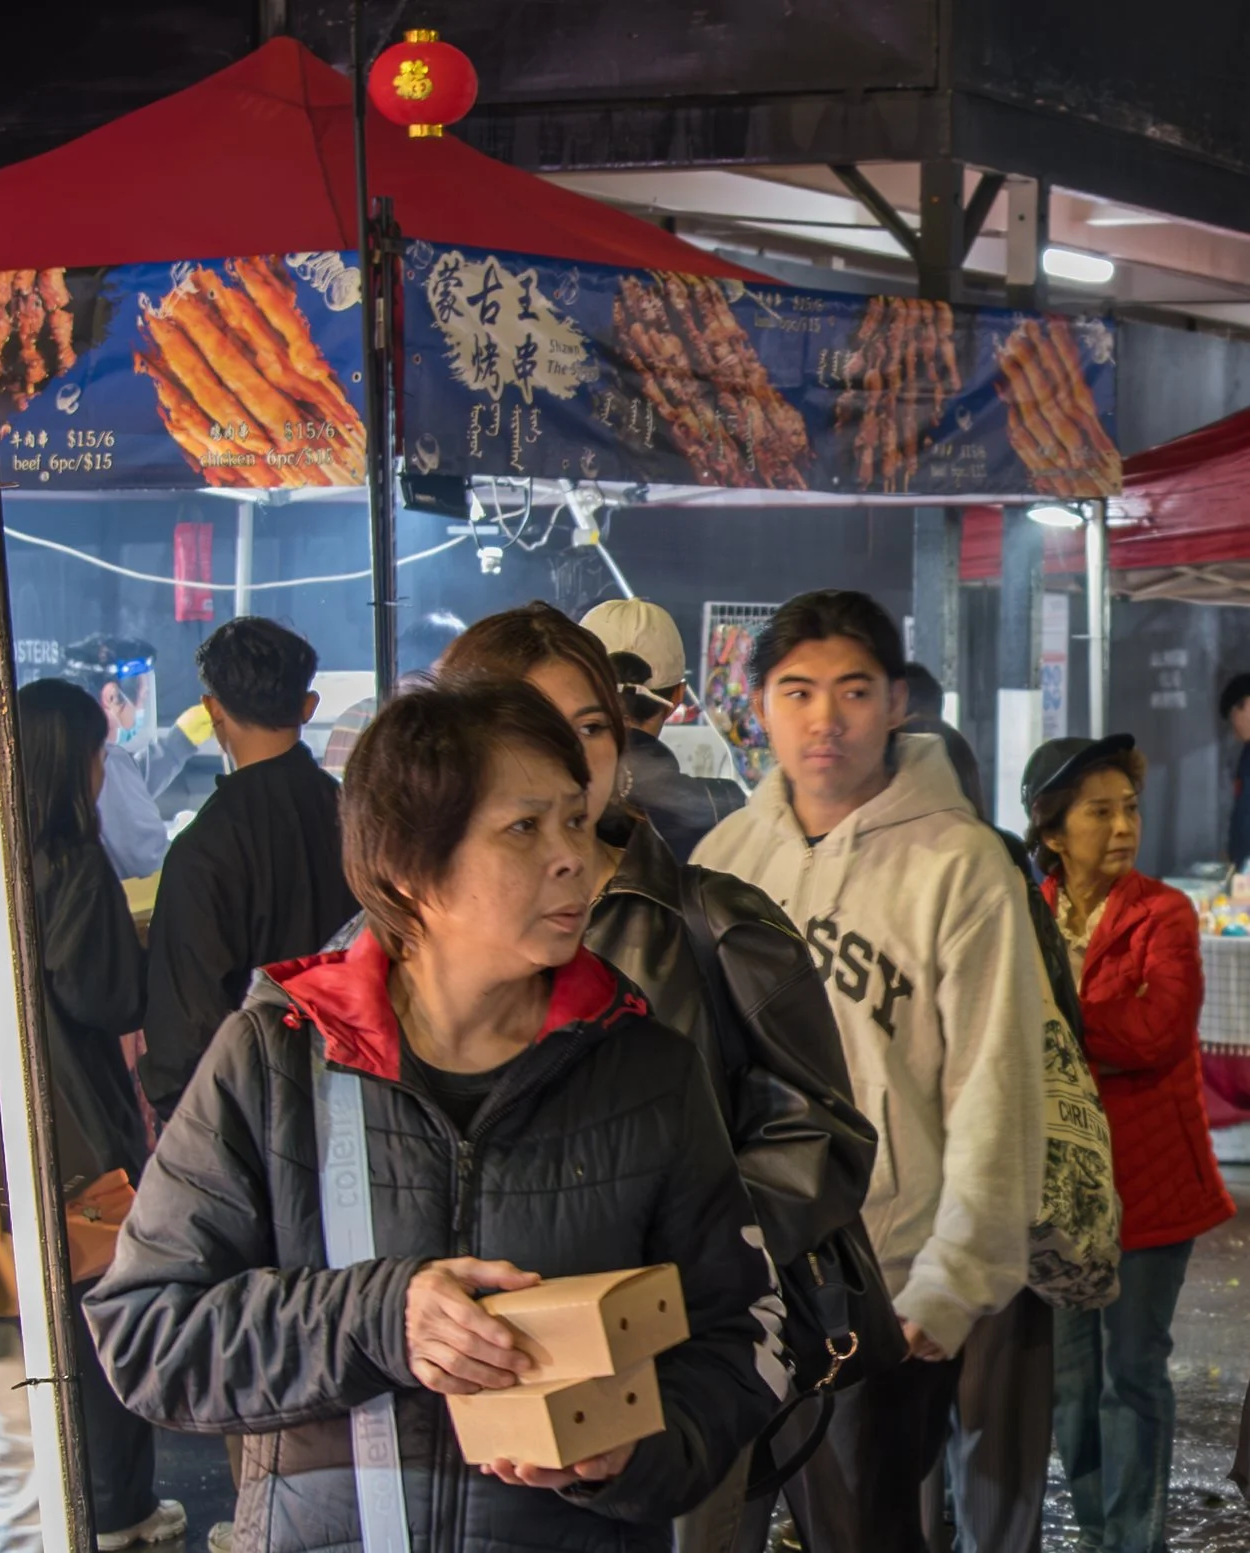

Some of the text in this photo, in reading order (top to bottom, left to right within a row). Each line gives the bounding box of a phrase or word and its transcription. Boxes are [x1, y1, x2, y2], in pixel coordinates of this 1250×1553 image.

[433, 258, 539, 326] 蒙古王
[470, 332, 539, 384] 烤串
[67, 428, 115, 448] $15/6
[284, 419, 335, 442] $15/6
[13, 452, 113, 474] beef 6pc/$15
[200, 451, 256, 467] chicken
[15, 639, 59, 664] STERS
[358, 1411, 394, 1516] colett
